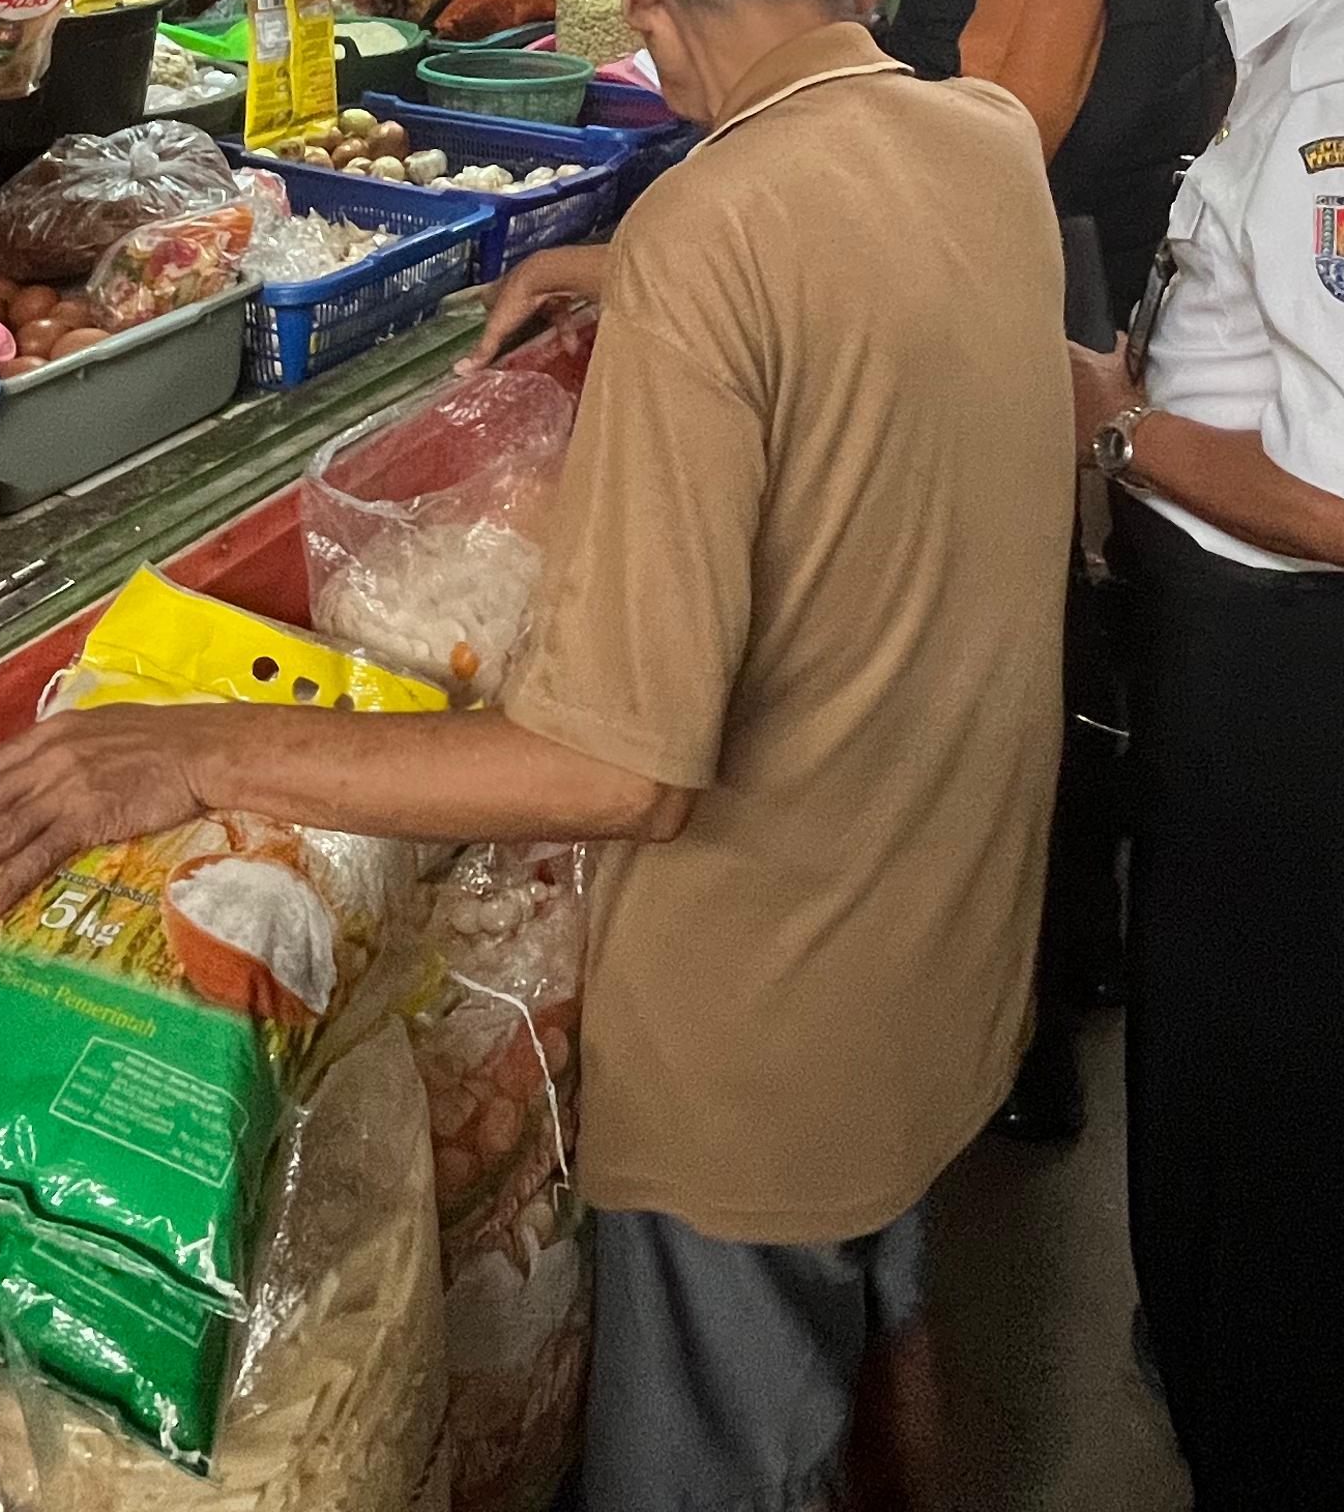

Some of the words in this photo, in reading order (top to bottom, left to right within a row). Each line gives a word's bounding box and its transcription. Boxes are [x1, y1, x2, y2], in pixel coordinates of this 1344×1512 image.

[40, 890, 89, 929] 5
[75, 909, 126, 949] kg
[54, 985, 158, 1038] Pemerintah
